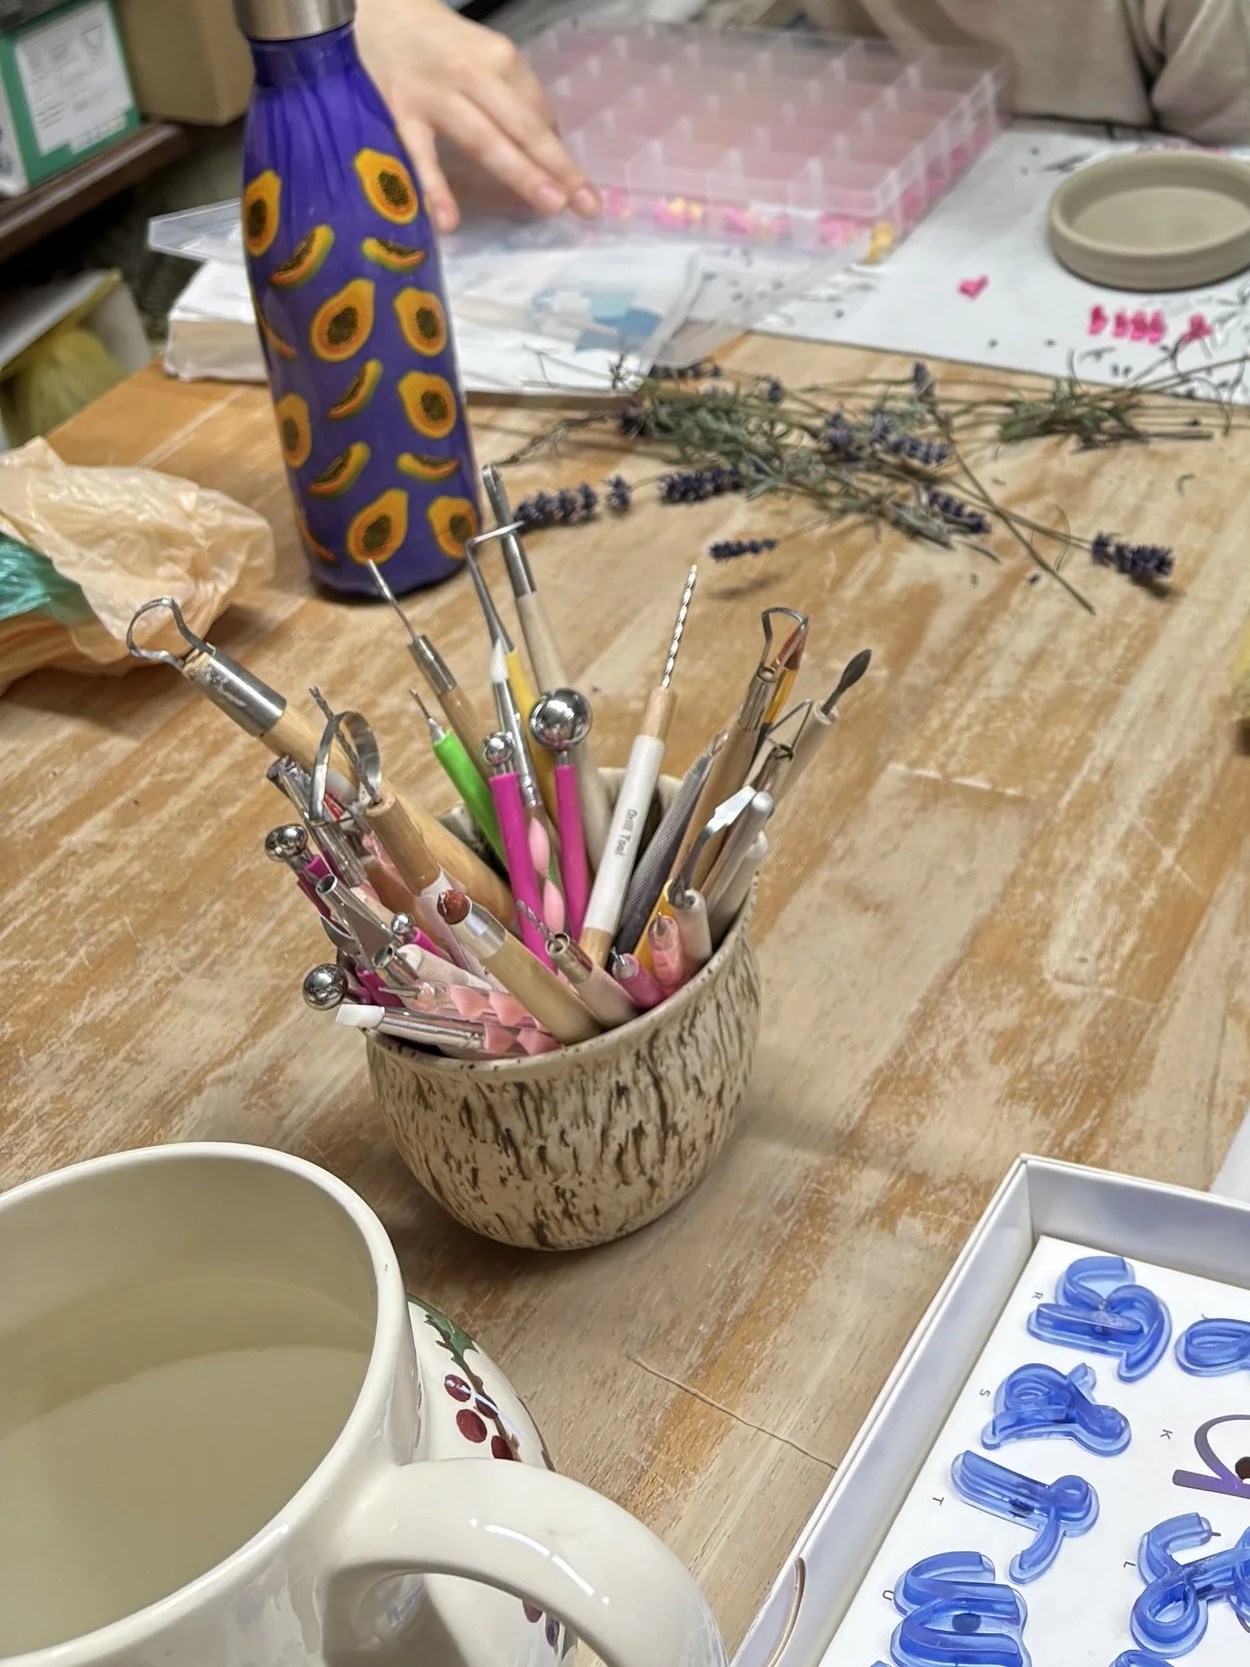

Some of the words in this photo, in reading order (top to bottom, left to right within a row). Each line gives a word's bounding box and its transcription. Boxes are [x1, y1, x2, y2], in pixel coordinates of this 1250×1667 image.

[615, 834, 632, 856] Tool
[1161, 1428, 1173, 1440] K
[932, 1495, 944, 1505] T
[1123, 1560, 1136, 1569] L
[882, 1589, 894, 1601] U
